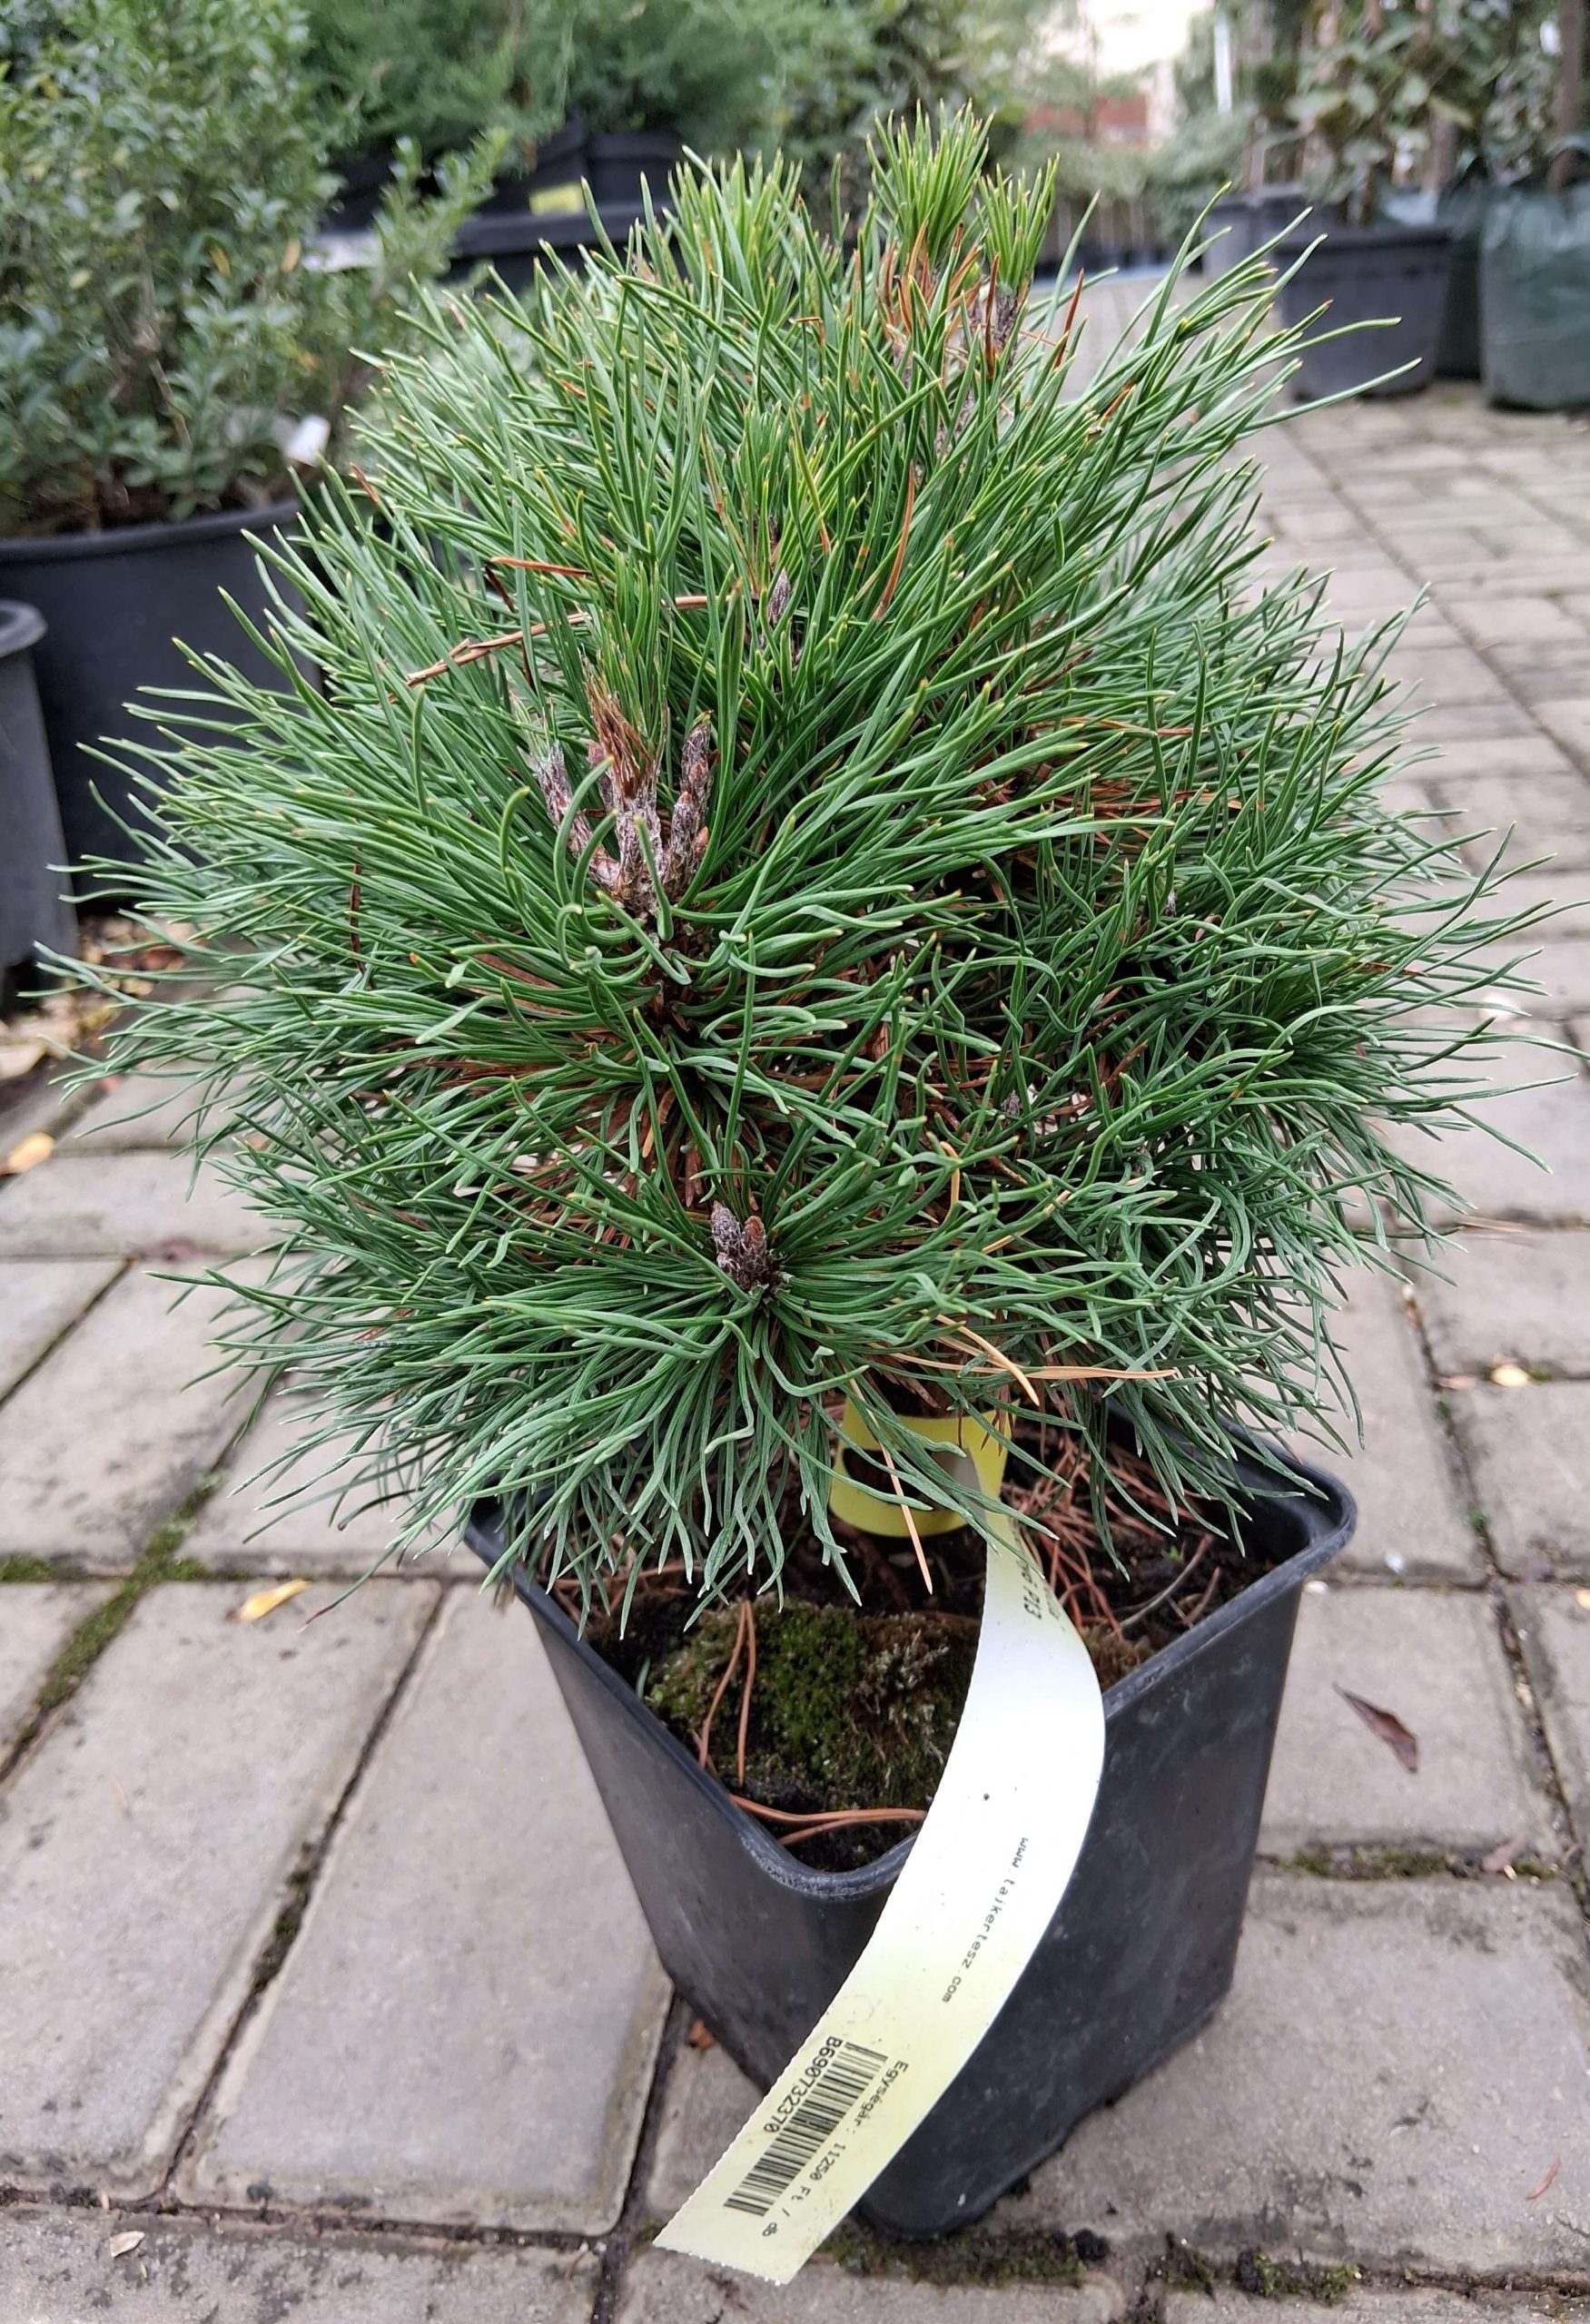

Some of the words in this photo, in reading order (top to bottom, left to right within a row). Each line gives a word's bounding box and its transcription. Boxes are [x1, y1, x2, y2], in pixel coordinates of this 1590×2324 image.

[942, 1837, 1028, 2003] www.tajkertesz.com
[763, 2036, 843, 2132] B690732370
[809, 2142, 846, 2181] 11250
[791, 2185, 812, 2201] Ft
[762, 2222, 778, 2237] db
